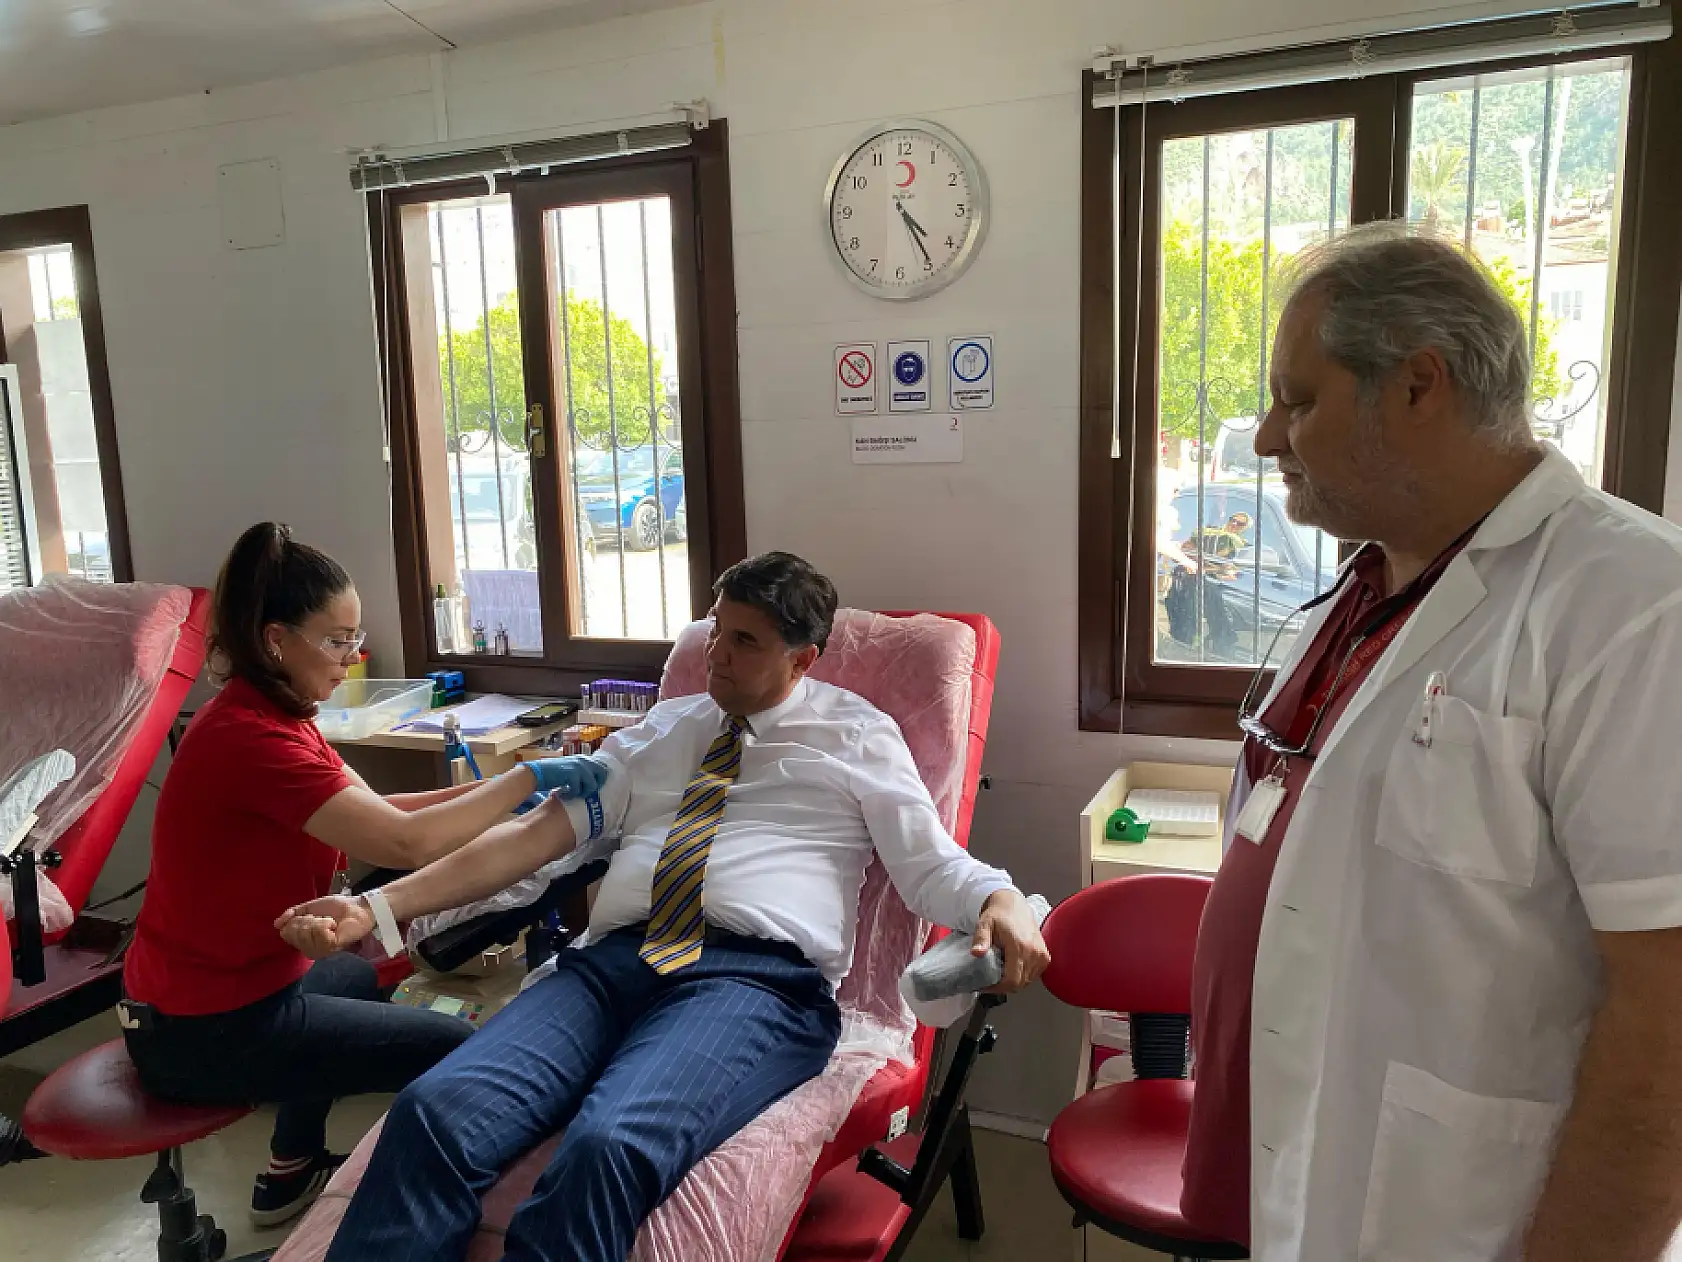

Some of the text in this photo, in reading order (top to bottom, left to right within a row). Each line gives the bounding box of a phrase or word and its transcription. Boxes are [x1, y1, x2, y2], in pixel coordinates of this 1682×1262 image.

[897, 141, 912, 156] 12
[873, 153, 883, 166] 11
[853, 175, 868, 190] 10
[948, 172, 958, 187] 2
[842, 205, 853, 220] 9
[849, 236, 861, 251] 8
[944, 235, 954, 249] 4
[870, 258, 879, 272] 7
[895, 266, 905, 280] 6
